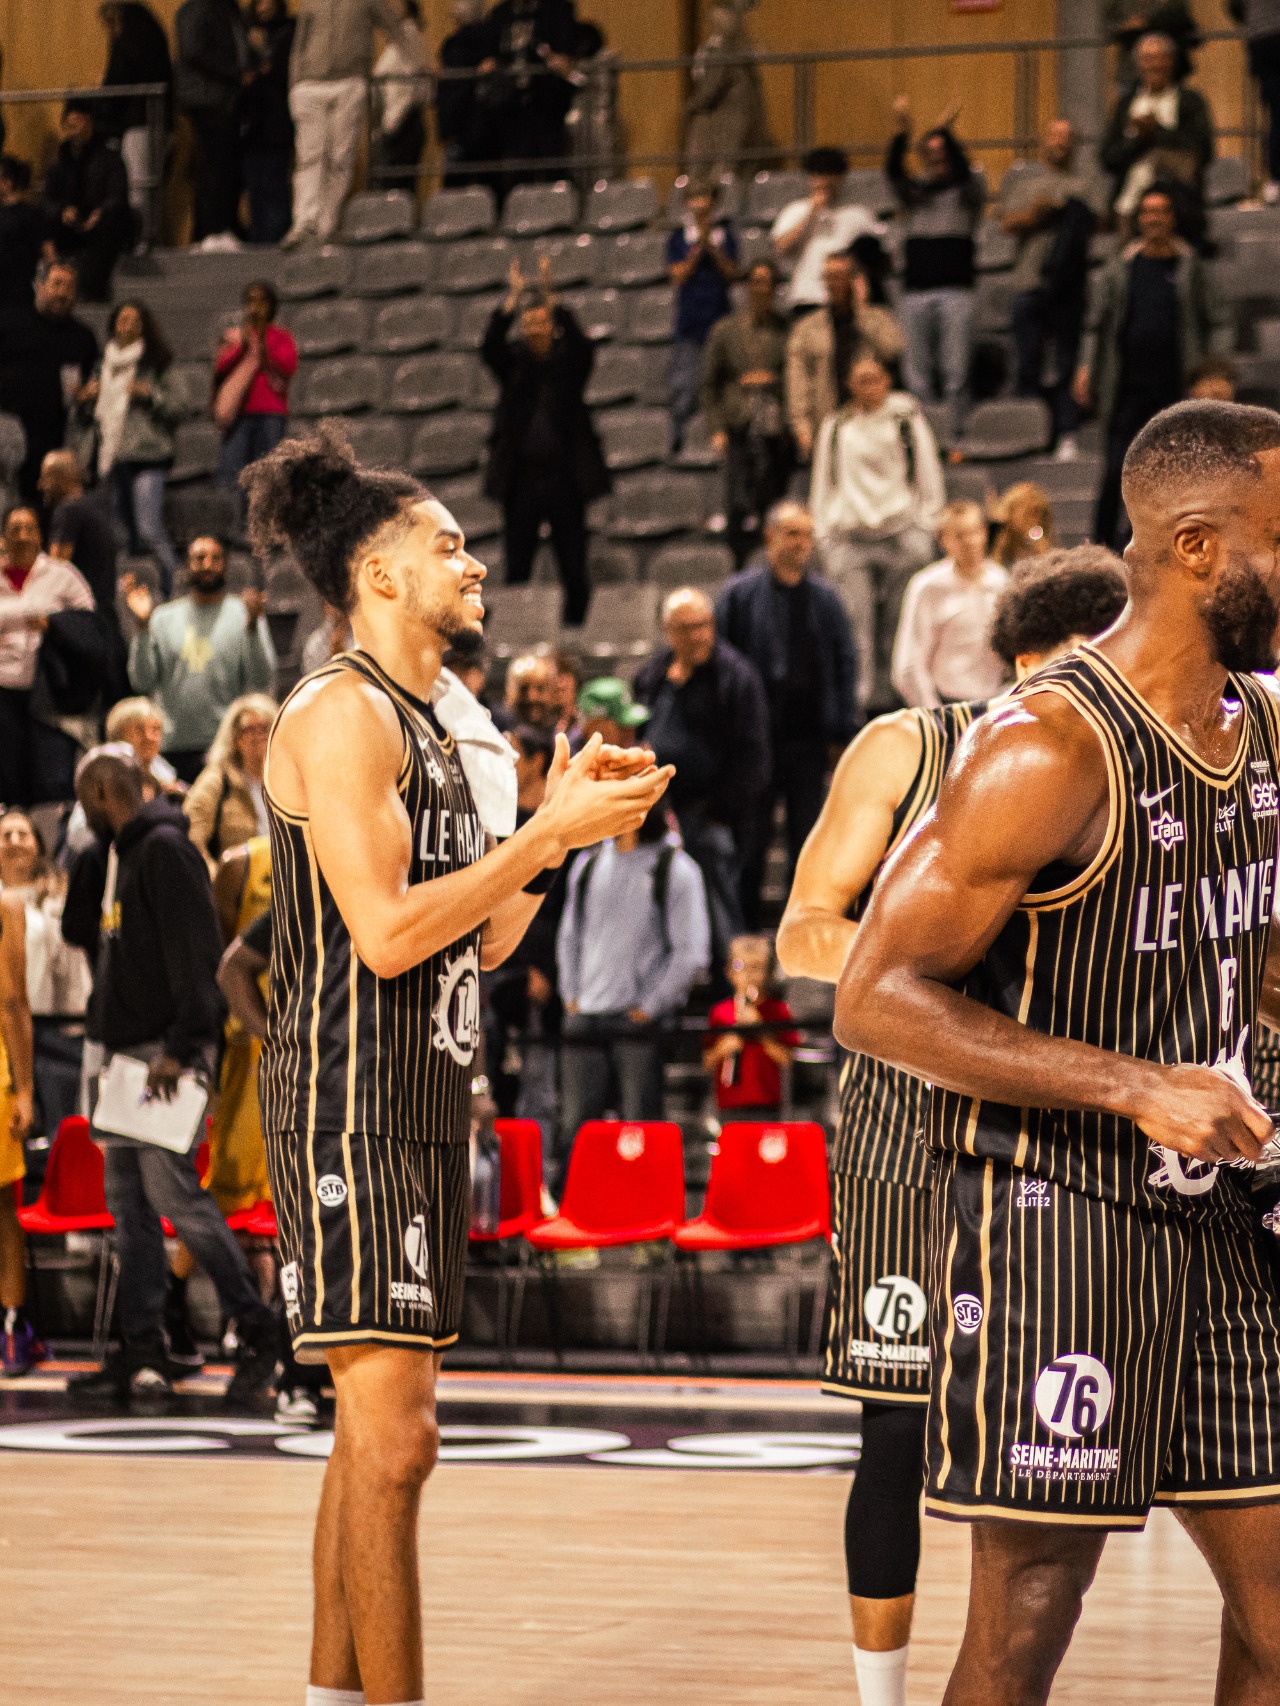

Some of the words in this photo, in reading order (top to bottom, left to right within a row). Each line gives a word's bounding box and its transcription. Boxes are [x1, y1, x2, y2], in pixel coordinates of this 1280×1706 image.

[420, 809, 450, 862] LE
[1134, 883, 1182, 951] LE
[320, 1182, 345, 1197] STB
[875, 1282, 913, 1337] 76
[956, 1303, 980, 1322] STB
[1047, 1362, 1100, 1437] 76
[1010, 1443, 1119, 1470] SEINE-MARITIME
[1018, 1468, 1032, 1478] LE
